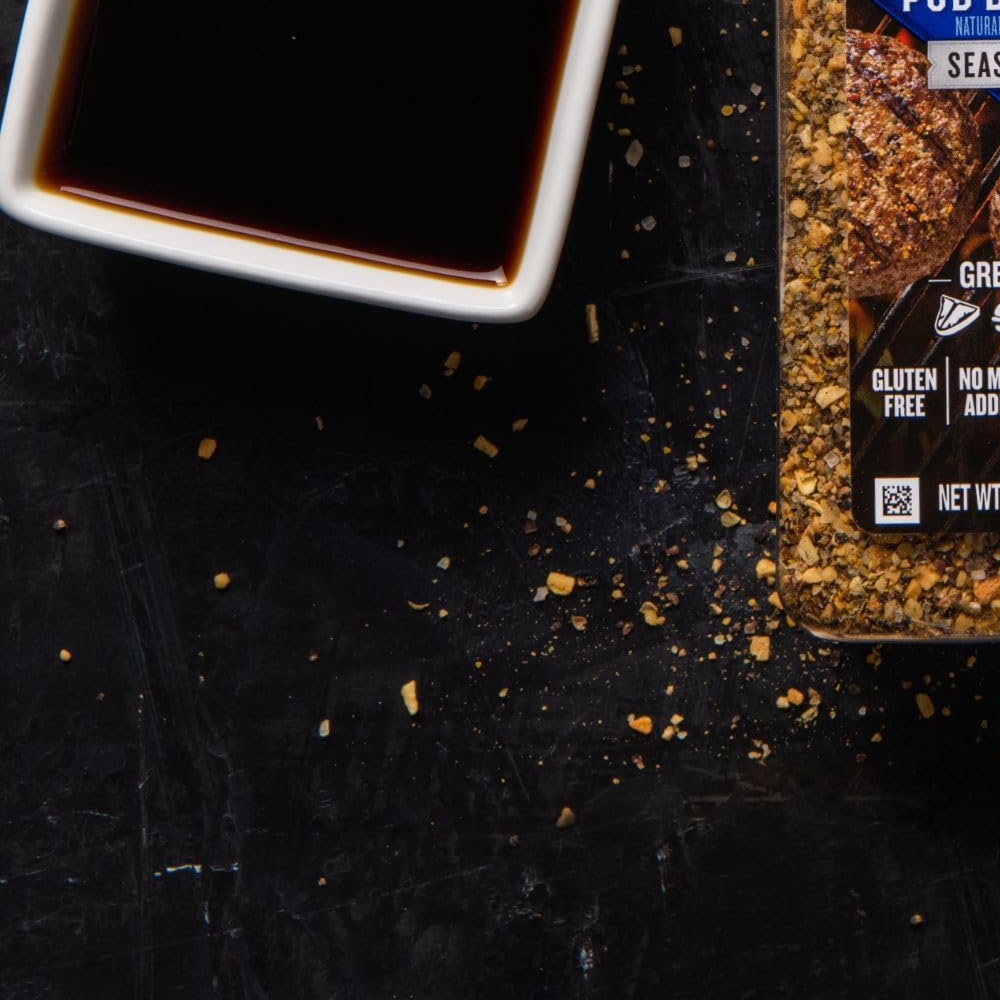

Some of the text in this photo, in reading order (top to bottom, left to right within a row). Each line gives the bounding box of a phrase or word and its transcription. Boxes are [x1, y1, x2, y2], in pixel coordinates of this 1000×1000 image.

[872, 368, 937, 391] GLUTEN
[959, 367, 983, 390] NO
[884, 394, 926, 417] FREE
[938, 484, 971, 512] NET
[975, 483, 1000, 511] WT
